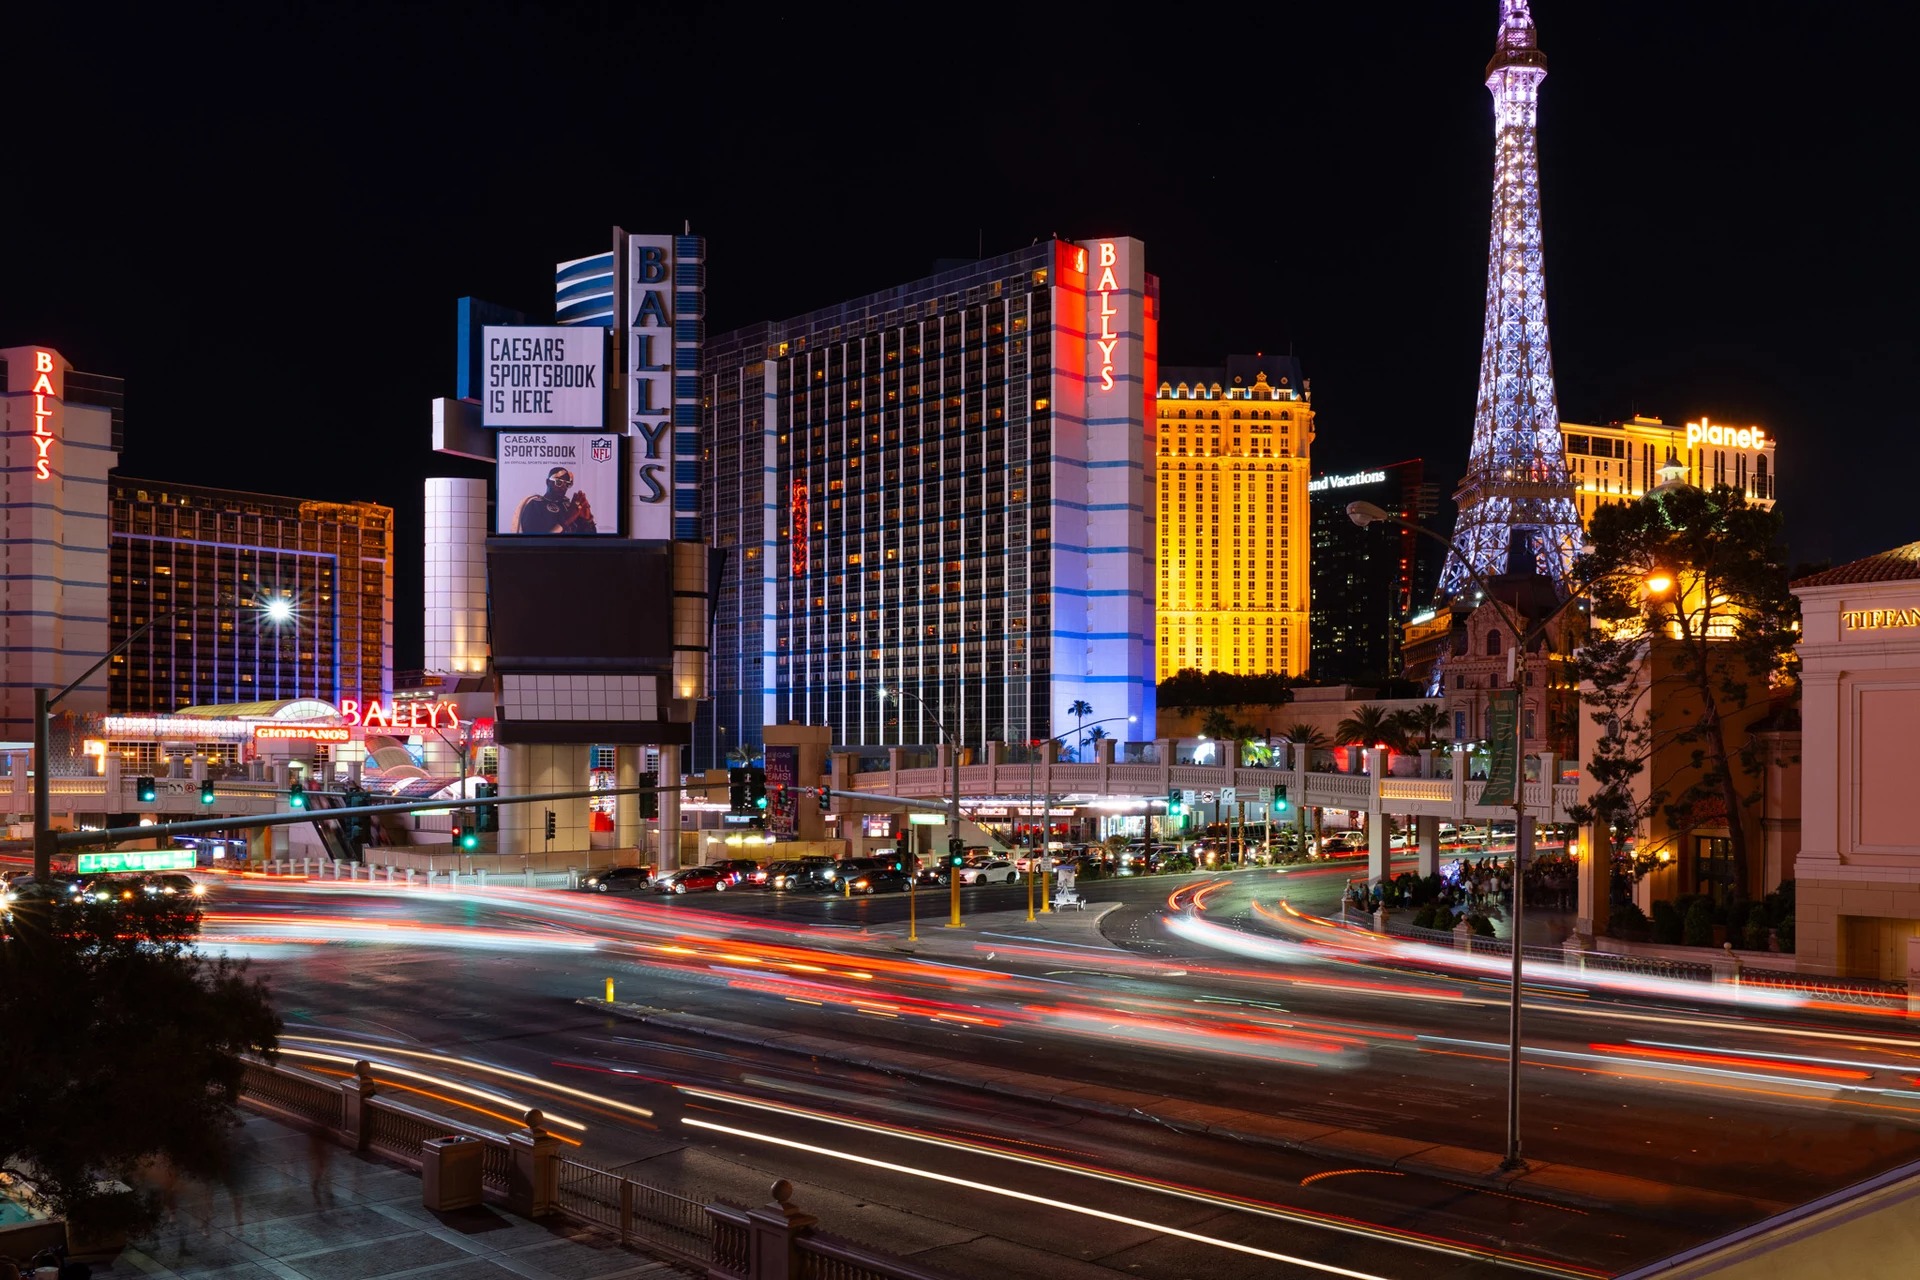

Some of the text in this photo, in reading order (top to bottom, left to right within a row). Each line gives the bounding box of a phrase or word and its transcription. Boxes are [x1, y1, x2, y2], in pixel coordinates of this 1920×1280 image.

[490, 338, 564, 361] CAESARS
[490, 364, 596, 388] SPORTSBOOK
[632, 245, 670, 503] BALLYS
[490, 390, 553, 413] IS HERE
[504, 436, 547, 444] CAESARS
[1686, 417, 1765, 450] planet
[504, 445, 576, 458] SPORTSBOOK
[593, 447, 610, 460] NFL
[1329, 471, 1386, 488] Vacations
[342, 699, 459, 730] BALLY'S
[256, 728, 349, 741] GIORDANO'S
[1486, 713, 1513, 796] LAS VEGAS
[90, 854, 119, 869] Las
